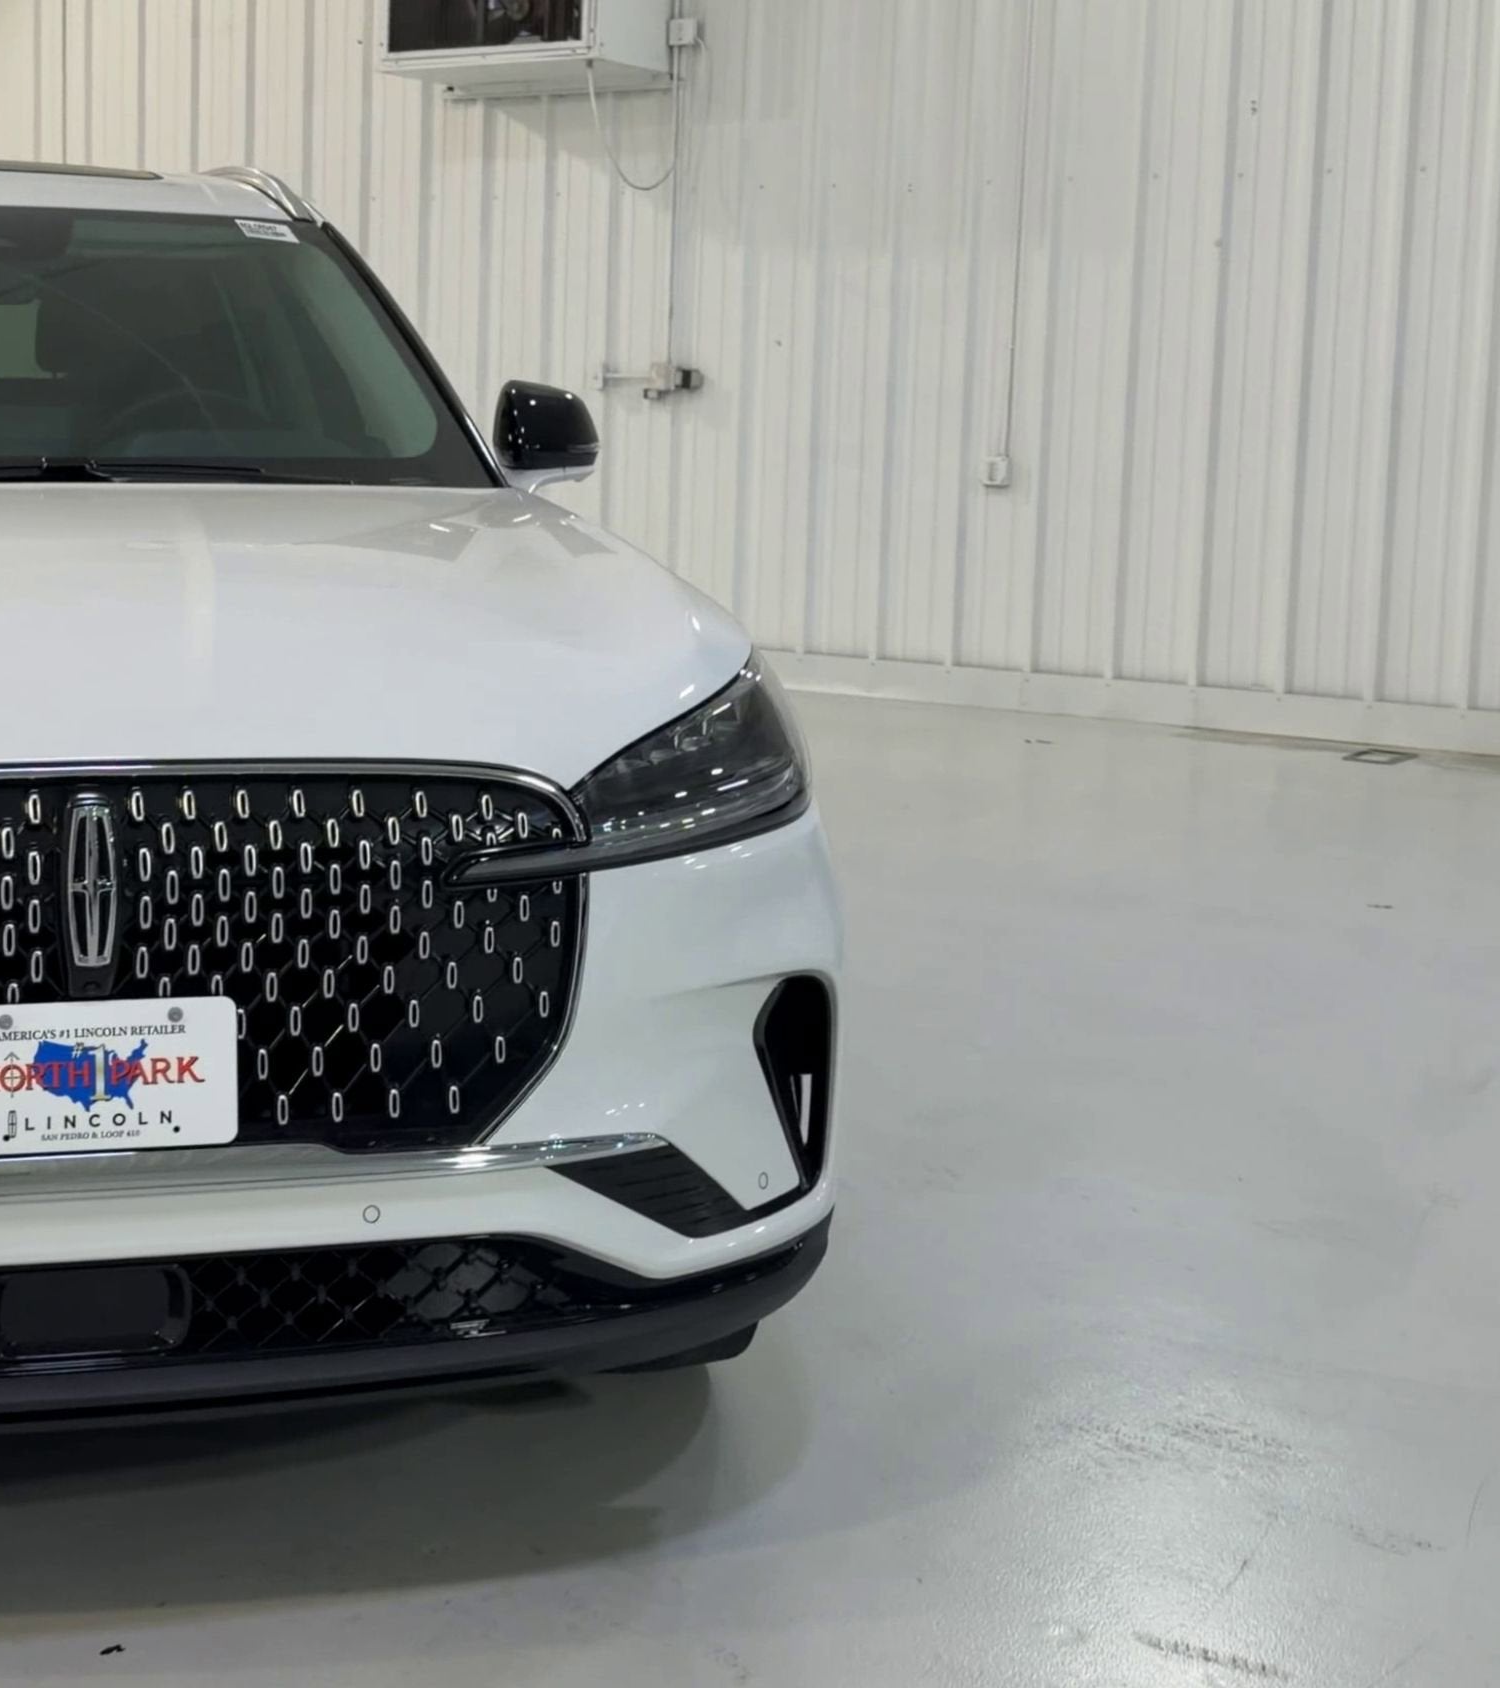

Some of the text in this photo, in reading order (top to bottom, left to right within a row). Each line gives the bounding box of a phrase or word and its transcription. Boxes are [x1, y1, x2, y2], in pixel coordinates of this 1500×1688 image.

[59, 1029, 71, 1039] #1
[74, 1026, 128, 1039] LINCOLN
[130, 1024, 186, 1036] RETAILER
[110, 1056, 205, 1086] PARK
[24, 1110, 173, 1131] LINCOLN
[41, 1133, 58, 1142] SAN
[60, 1132, 90, 1141] PEDRO
[91, 1131, 99, 1139] &
[100, 1130, 125, 1139] LOOP
